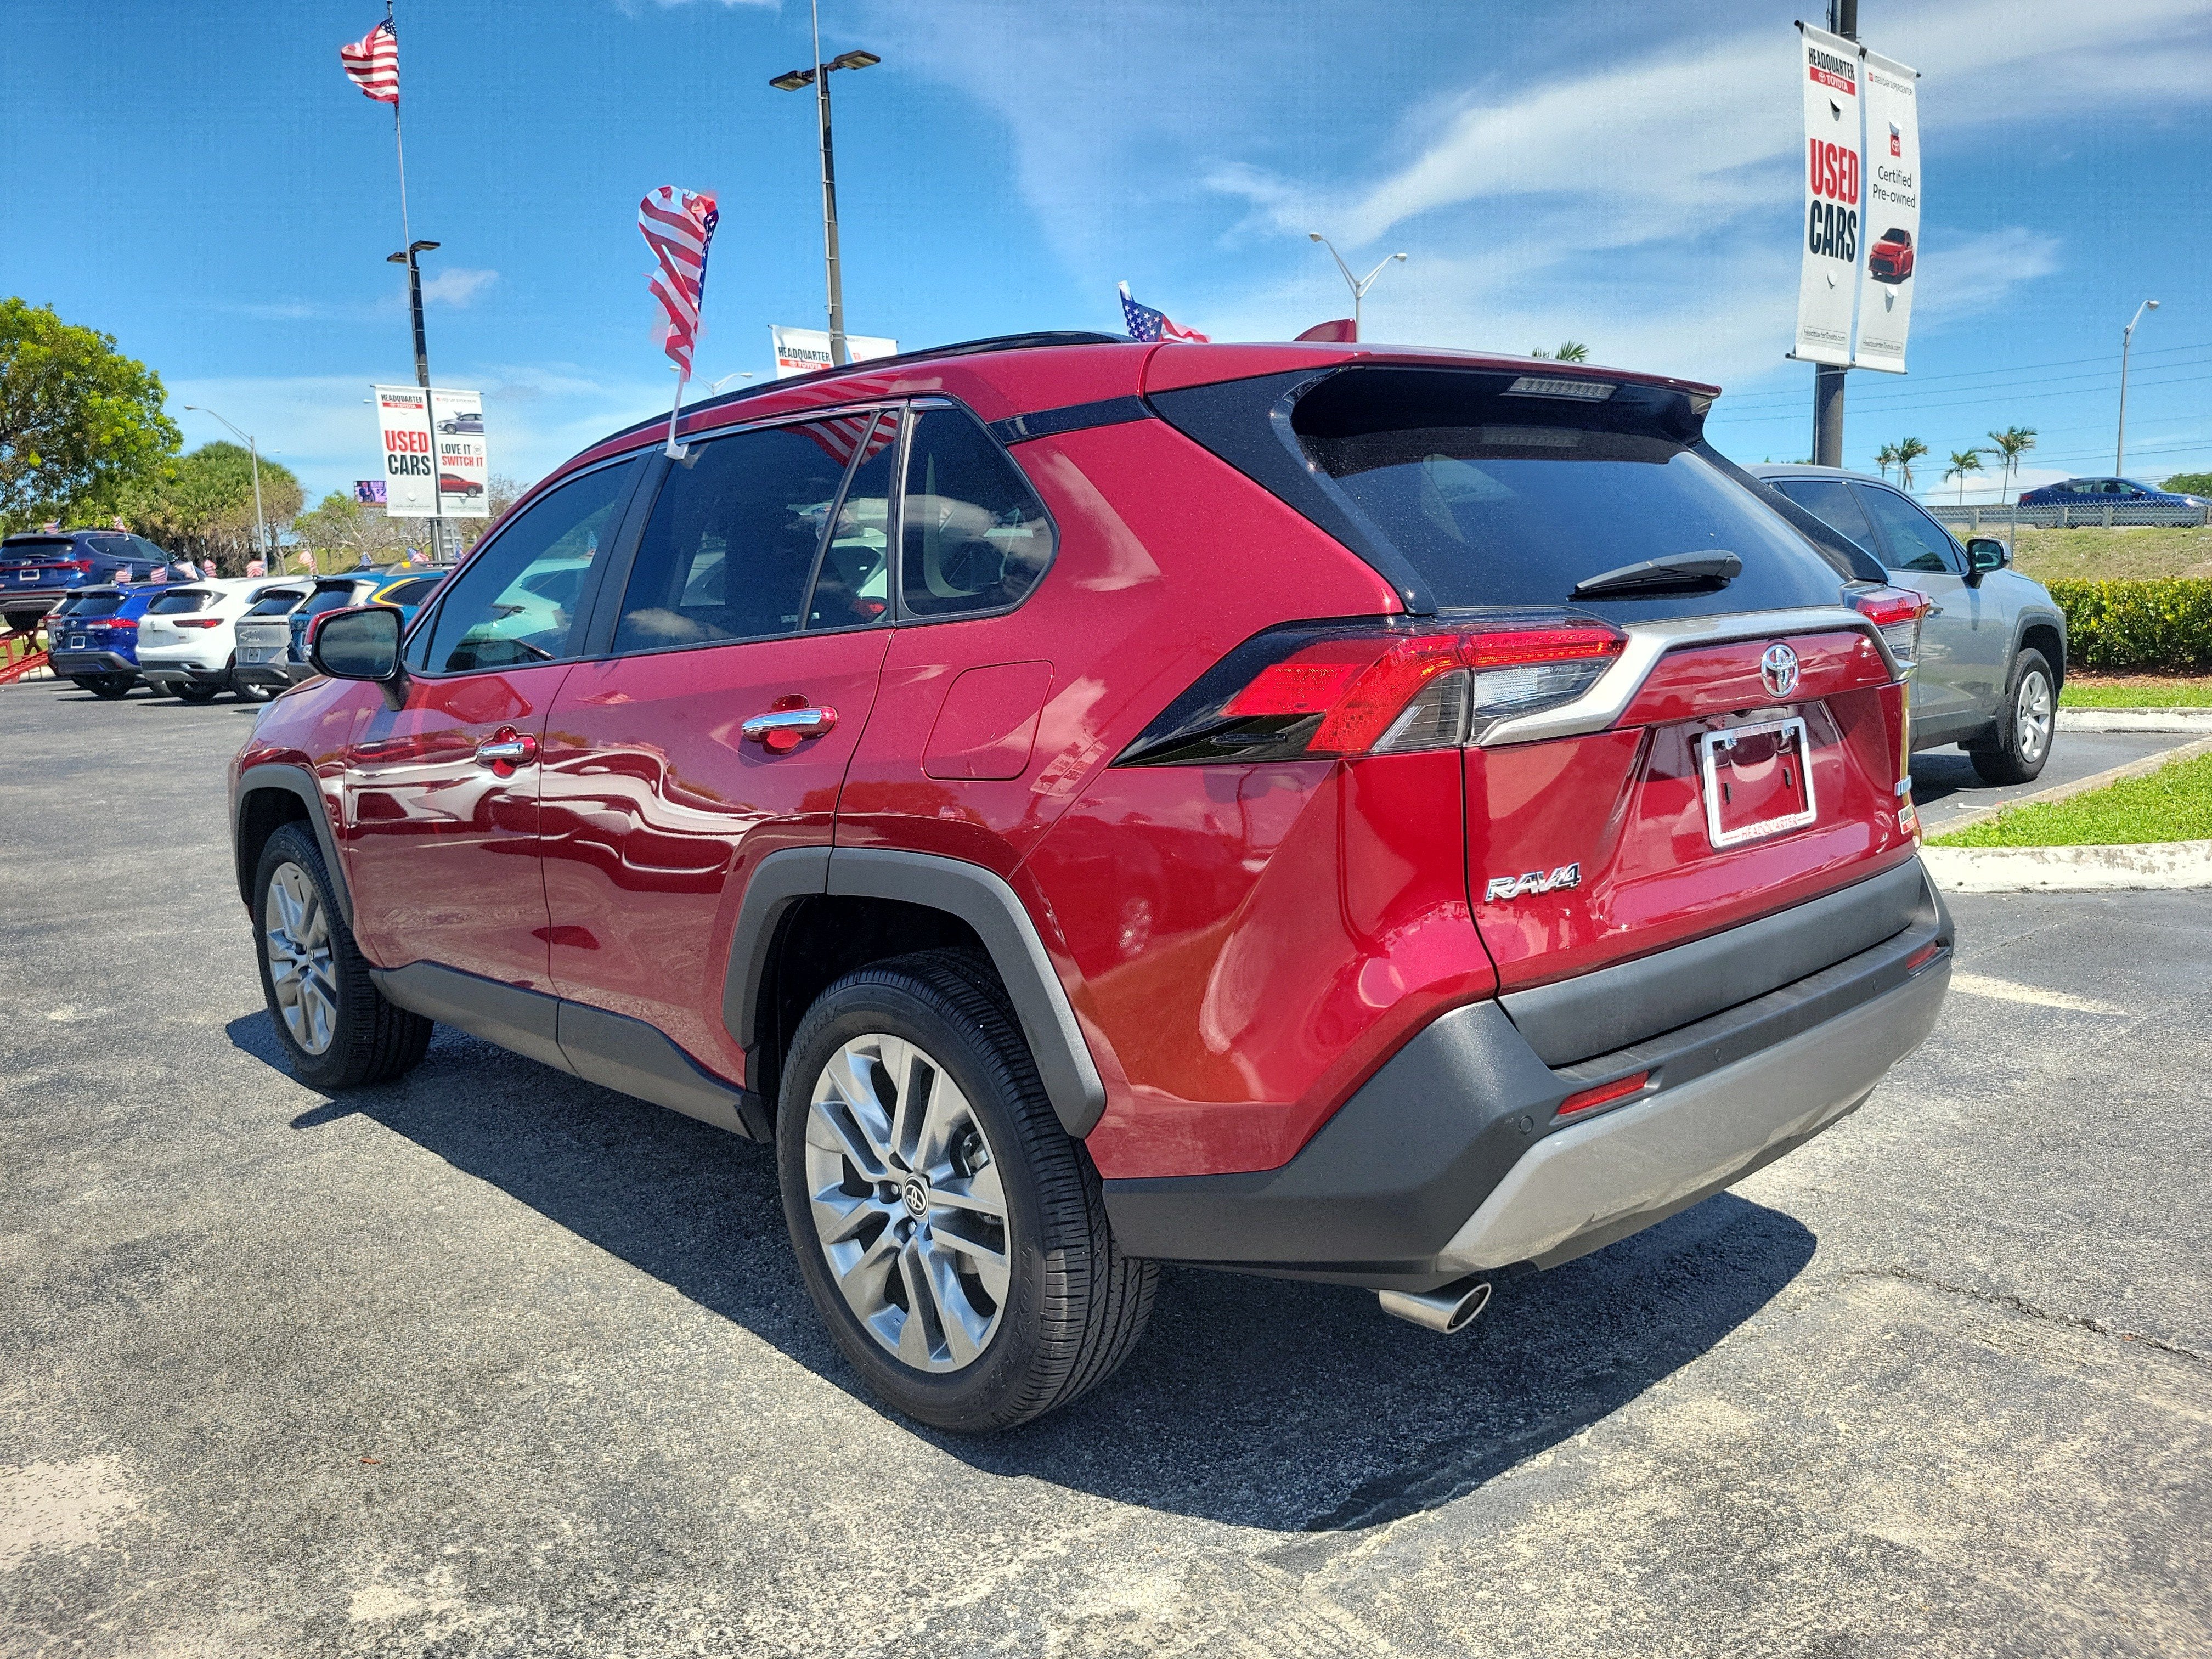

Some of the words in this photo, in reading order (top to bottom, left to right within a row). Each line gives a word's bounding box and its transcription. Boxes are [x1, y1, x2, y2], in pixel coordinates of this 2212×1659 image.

[1808, 46, 1855, 82] HEADQUARTER
[1825, 75, 1848, 92] TOYOTA
[1810, 138, 1858, 205] USED
[1877, 165, 1912, 188] Certified
[1872, 184, 1916, 208] Pre-owned
[1809, 199, 1857, 263] CARS
[778, 346, 831, 362] HEADQUARTER
[797, 361, 822, 370] TOYOTA
[381, 394, 423, 403] HEADQUARTER
[385, 430, 429, 453] USED
[441, 443, 461, 454] LOVE
[464, 444, 471, 455] IT
[387, 454, 431, 476] CARS
[442, 455, 474, 466] SWITCH
[476, 456, 483, 467] IT
[1741, 816, 1798, 839] HEADQUARTER
[1485, 862, 1582, 902] RAV4
